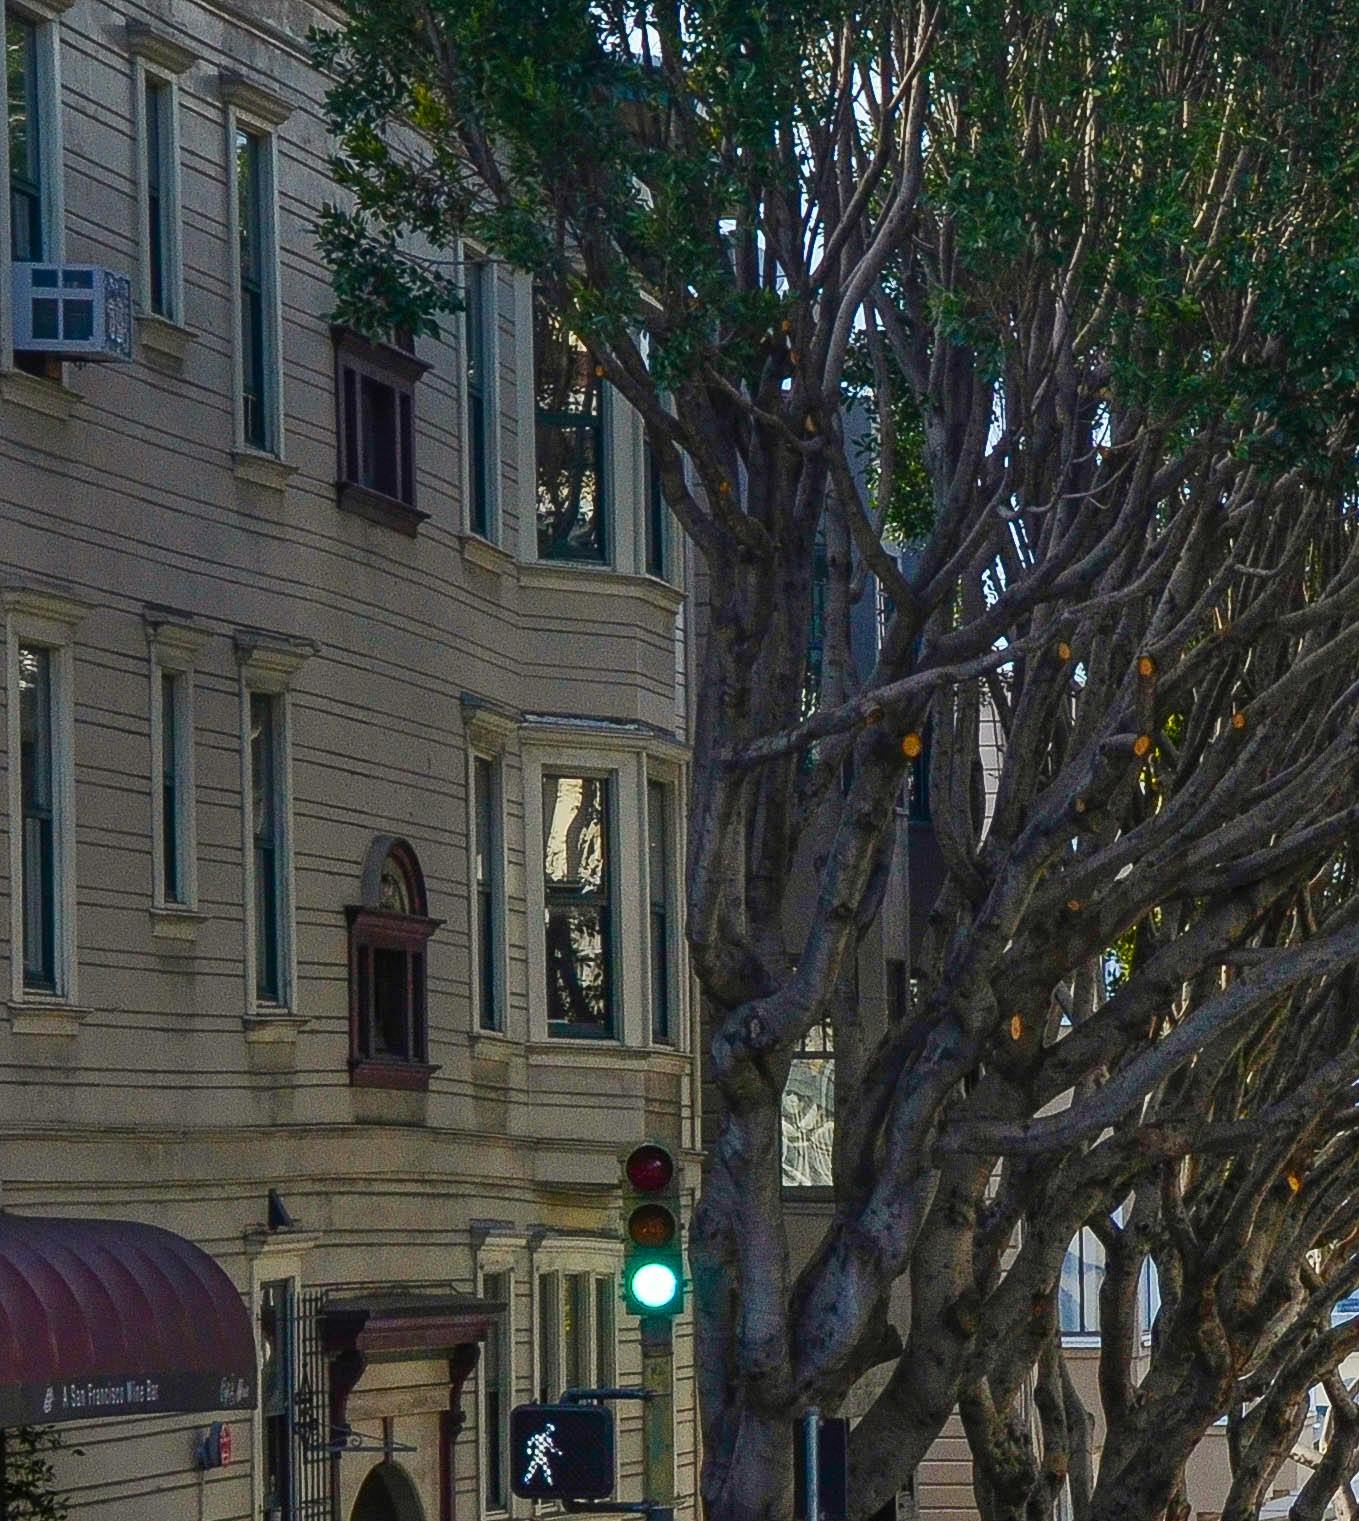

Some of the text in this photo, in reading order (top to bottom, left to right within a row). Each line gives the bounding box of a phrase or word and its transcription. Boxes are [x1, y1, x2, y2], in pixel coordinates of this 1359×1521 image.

[71, 1384, 86, 1407] San
[88, 1383, 124, 1405] Francisco
[126, 1381, 144, 1403] Wine
[146, 1379, 159, 1401] Bar
